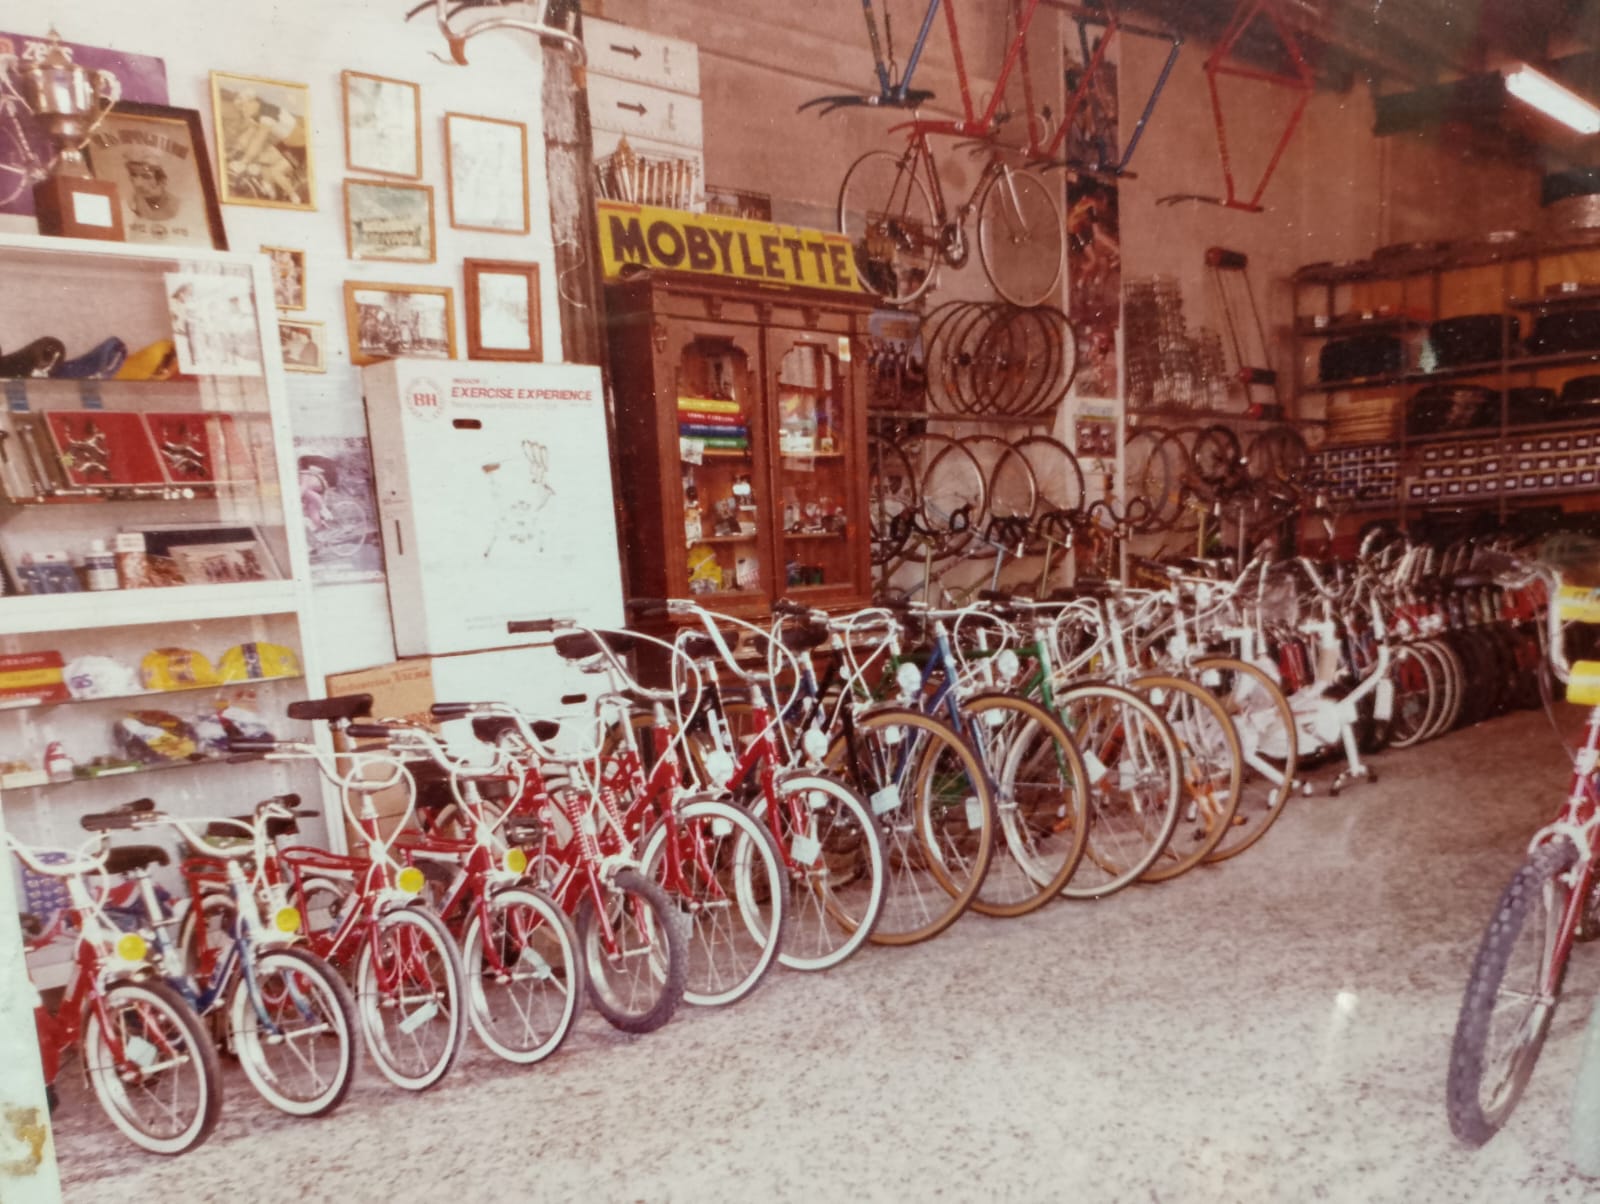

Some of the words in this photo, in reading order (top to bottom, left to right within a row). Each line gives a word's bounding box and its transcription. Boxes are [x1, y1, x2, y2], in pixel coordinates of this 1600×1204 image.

[22, 40, 74, 63] zes
[608, 215, 853, 288] MOBYLETTE
[413, 392, 437, 407] BH
[451, 386, 514, 399] EXERCISE
[517, 388, 593, 401] EXPERIENCE
